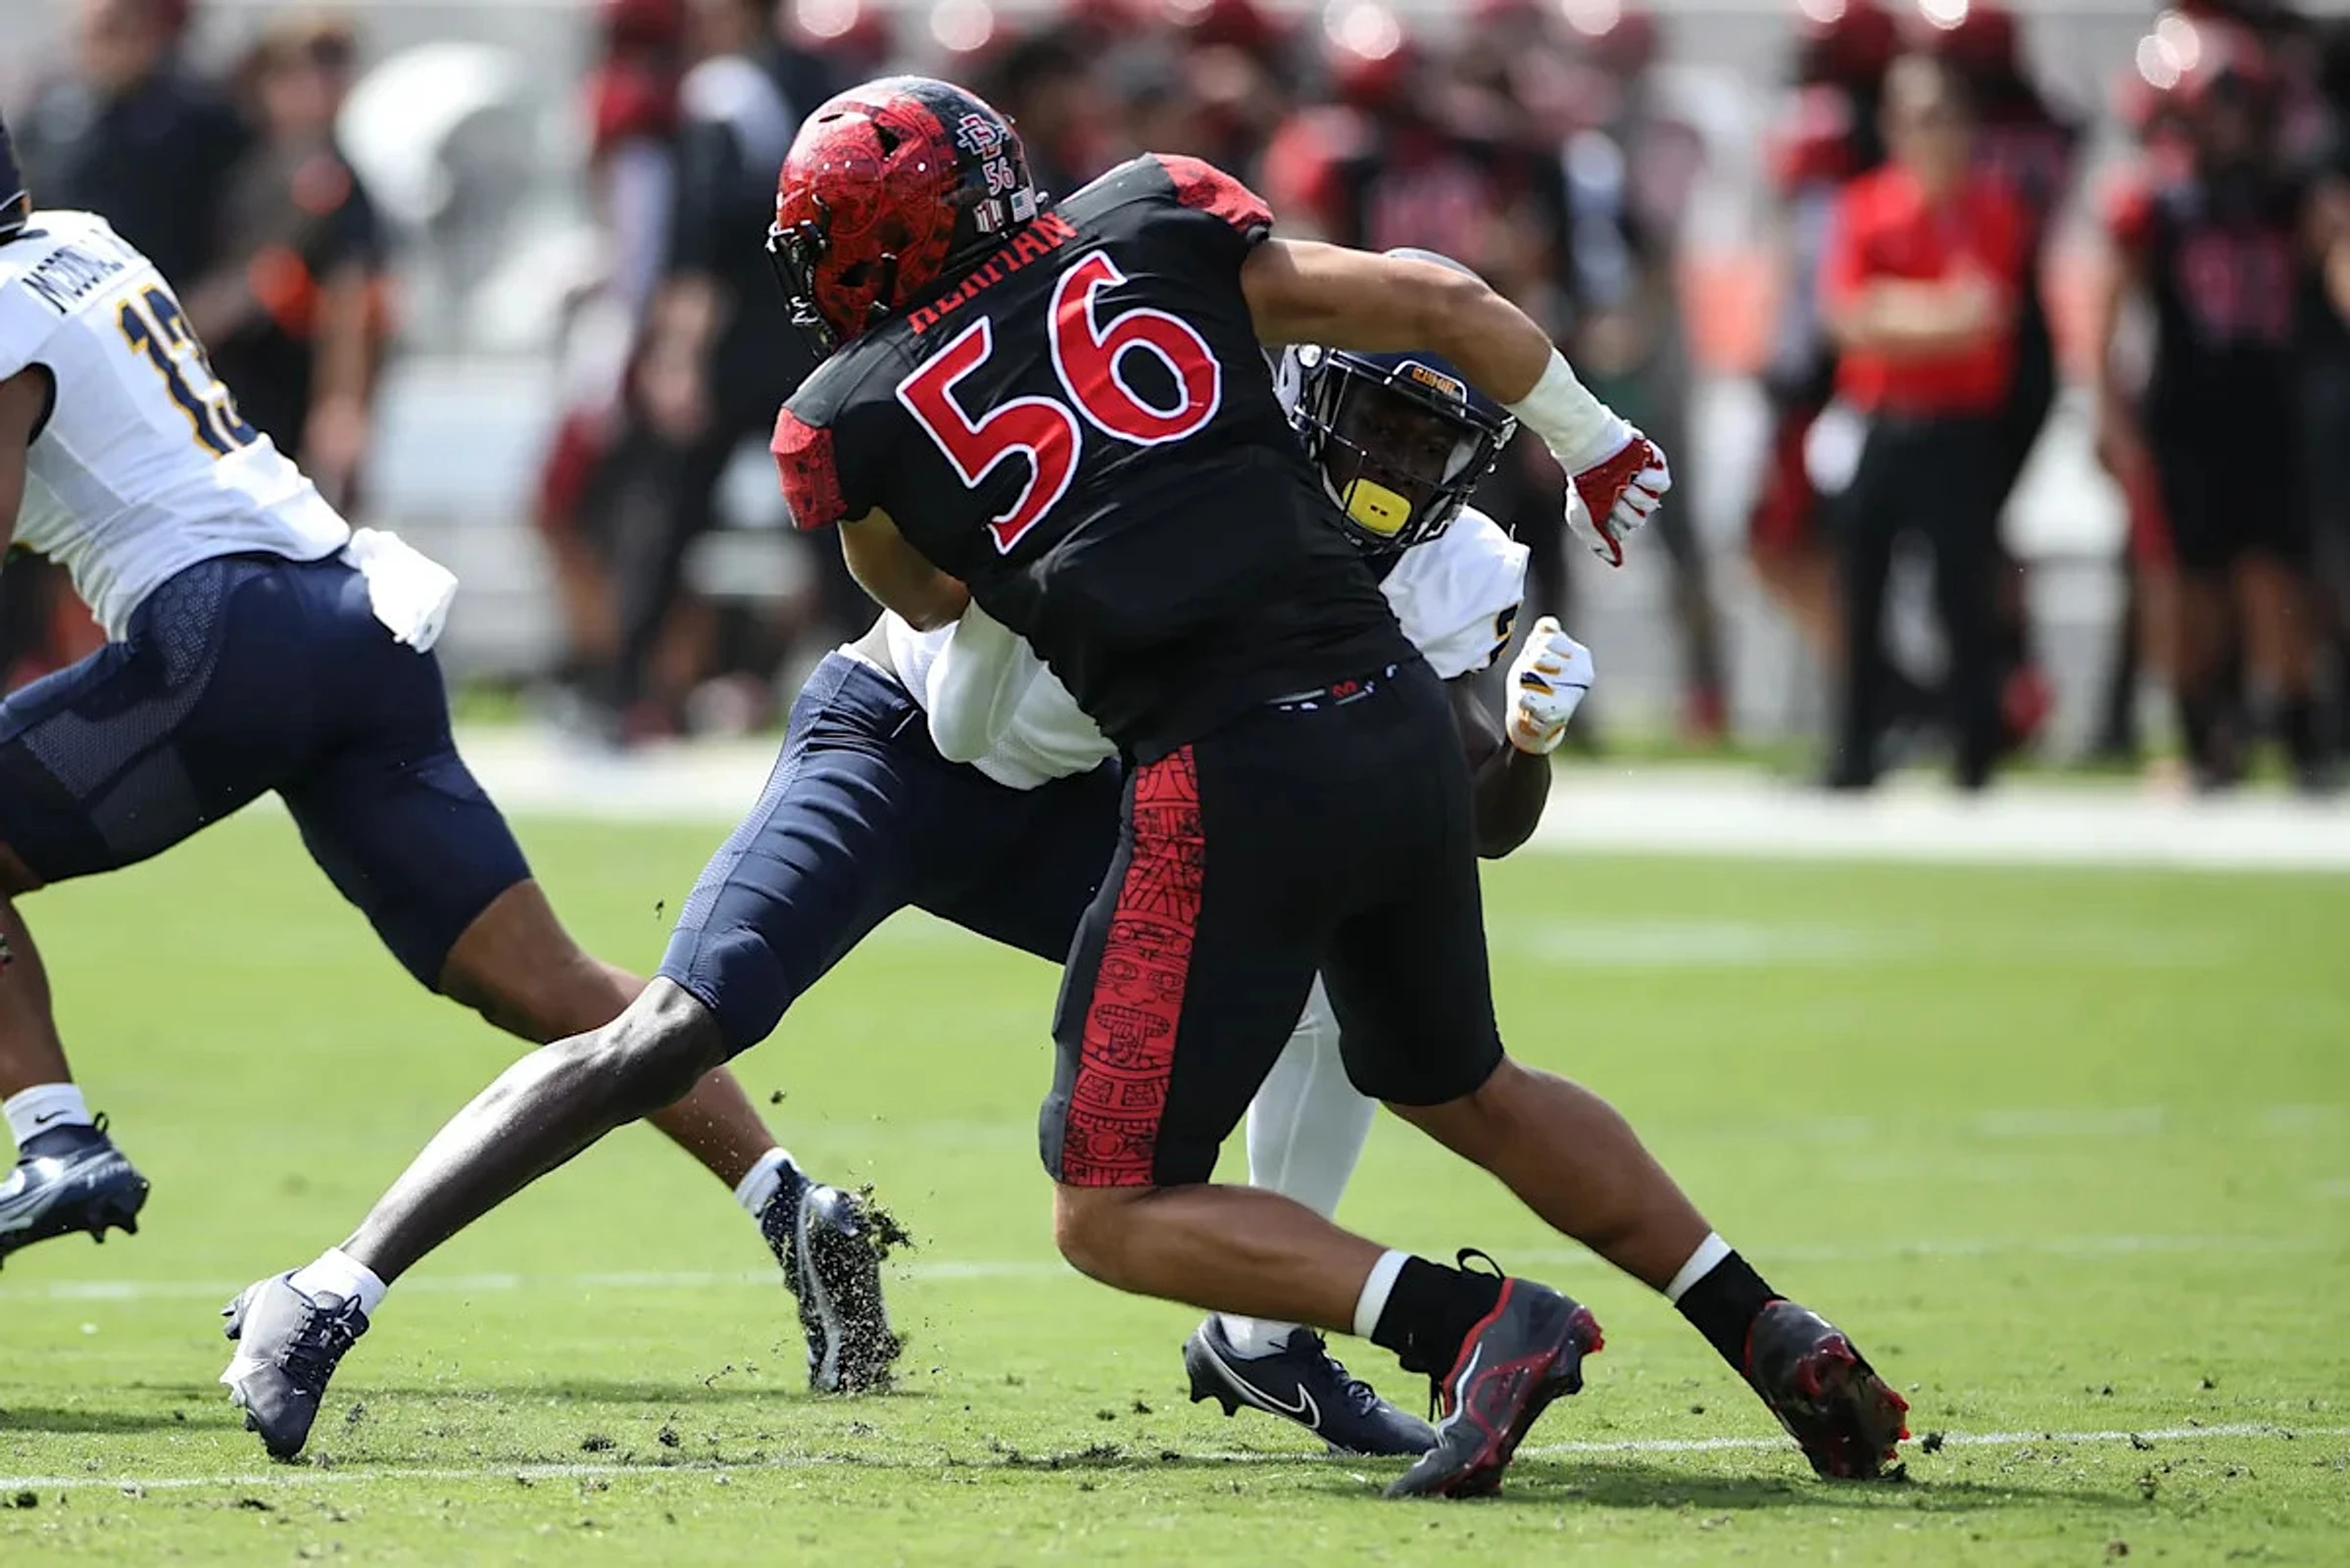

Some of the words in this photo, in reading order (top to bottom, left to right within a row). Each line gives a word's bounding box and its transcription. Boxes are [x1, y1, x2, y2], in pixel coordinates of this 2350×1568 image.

[982, 157, 1015, 197] 56
[115, 282, 259, 462] 13
[896, 249, 1222, 556] 56
